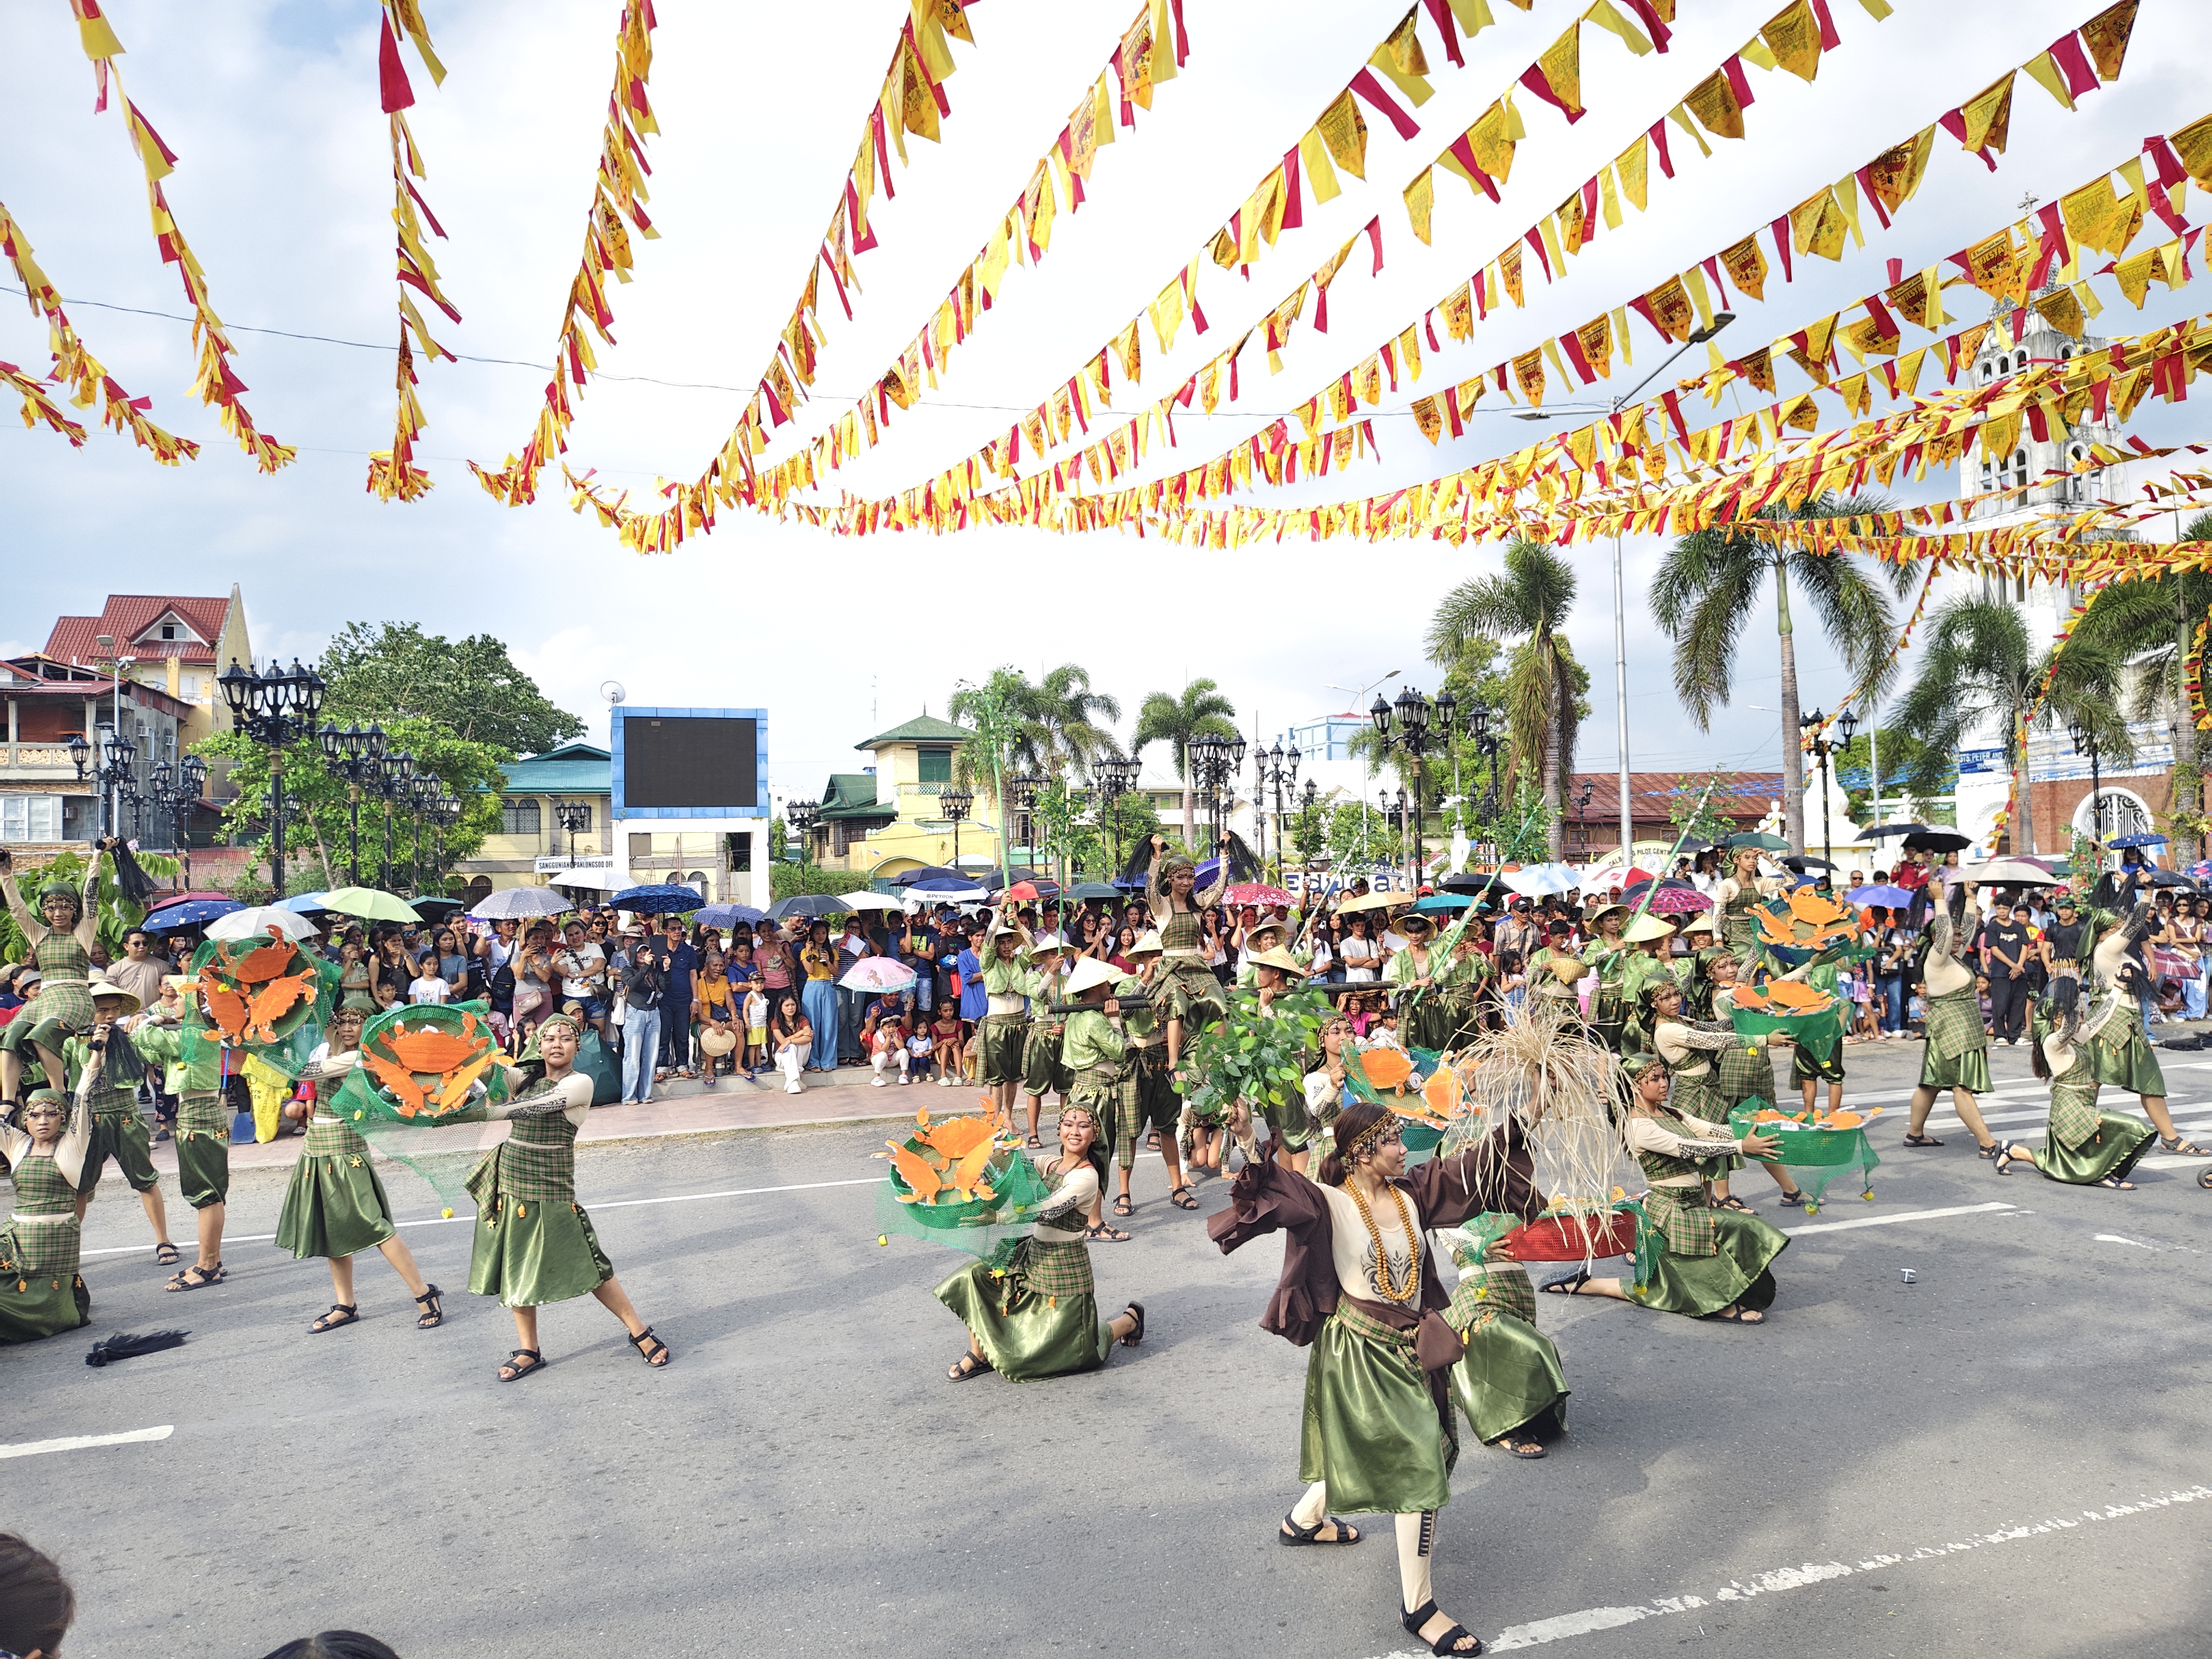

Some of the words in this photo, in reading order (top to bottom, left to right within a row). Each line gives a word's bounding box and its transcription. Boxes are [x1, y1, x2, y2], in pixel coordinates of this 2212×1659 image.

[1979, 246, 2005, 266] FIESTA
[1901, 285, 1924, 302] FIESTA
[1972, 752, 1990, 761] PETER
[1992, 751, 2003, 759] AND
[574, 860, 604, 868] PANLUNGSOD
[1608, 850, 1635, 867] CALBG
